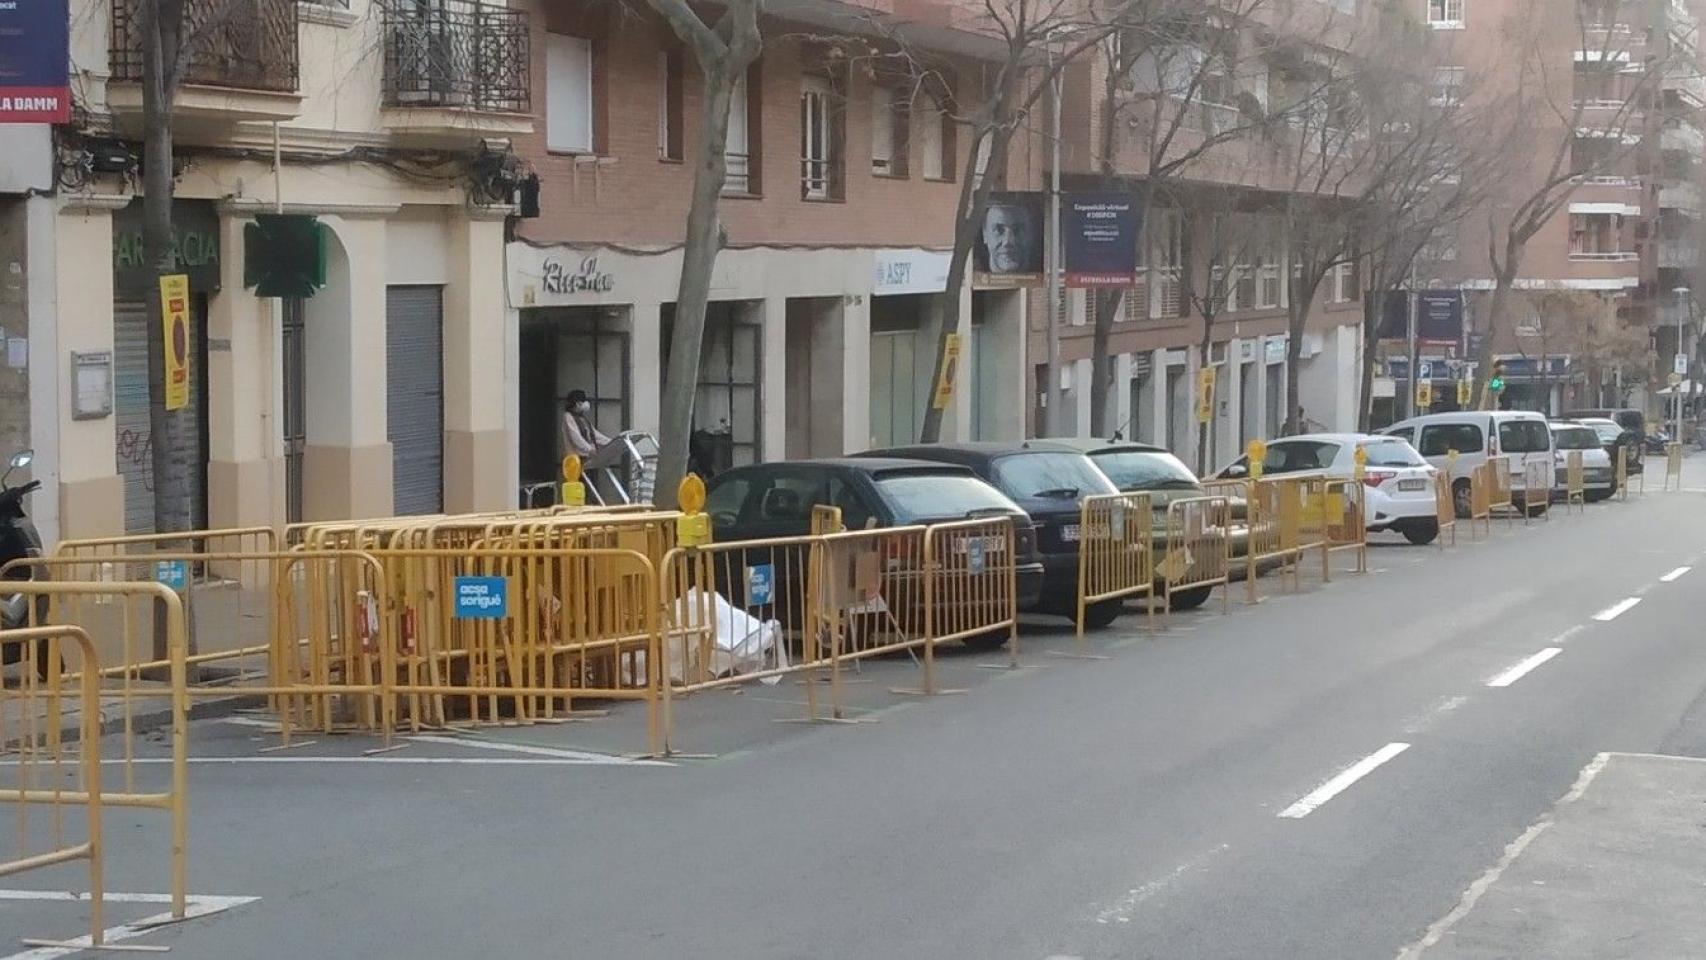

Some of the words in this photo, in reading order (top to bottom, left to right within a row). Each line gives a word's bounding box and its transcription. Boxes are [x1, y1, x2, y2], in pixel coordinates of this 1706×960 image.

[14, 97, 58, 110] DAMM
[114, 230, 218, 266] ARACIA
[886, 262, 912, 284] ASPY
[460, 585, 488, 594] acsa
[460, 594, 501, 609] sorigué
